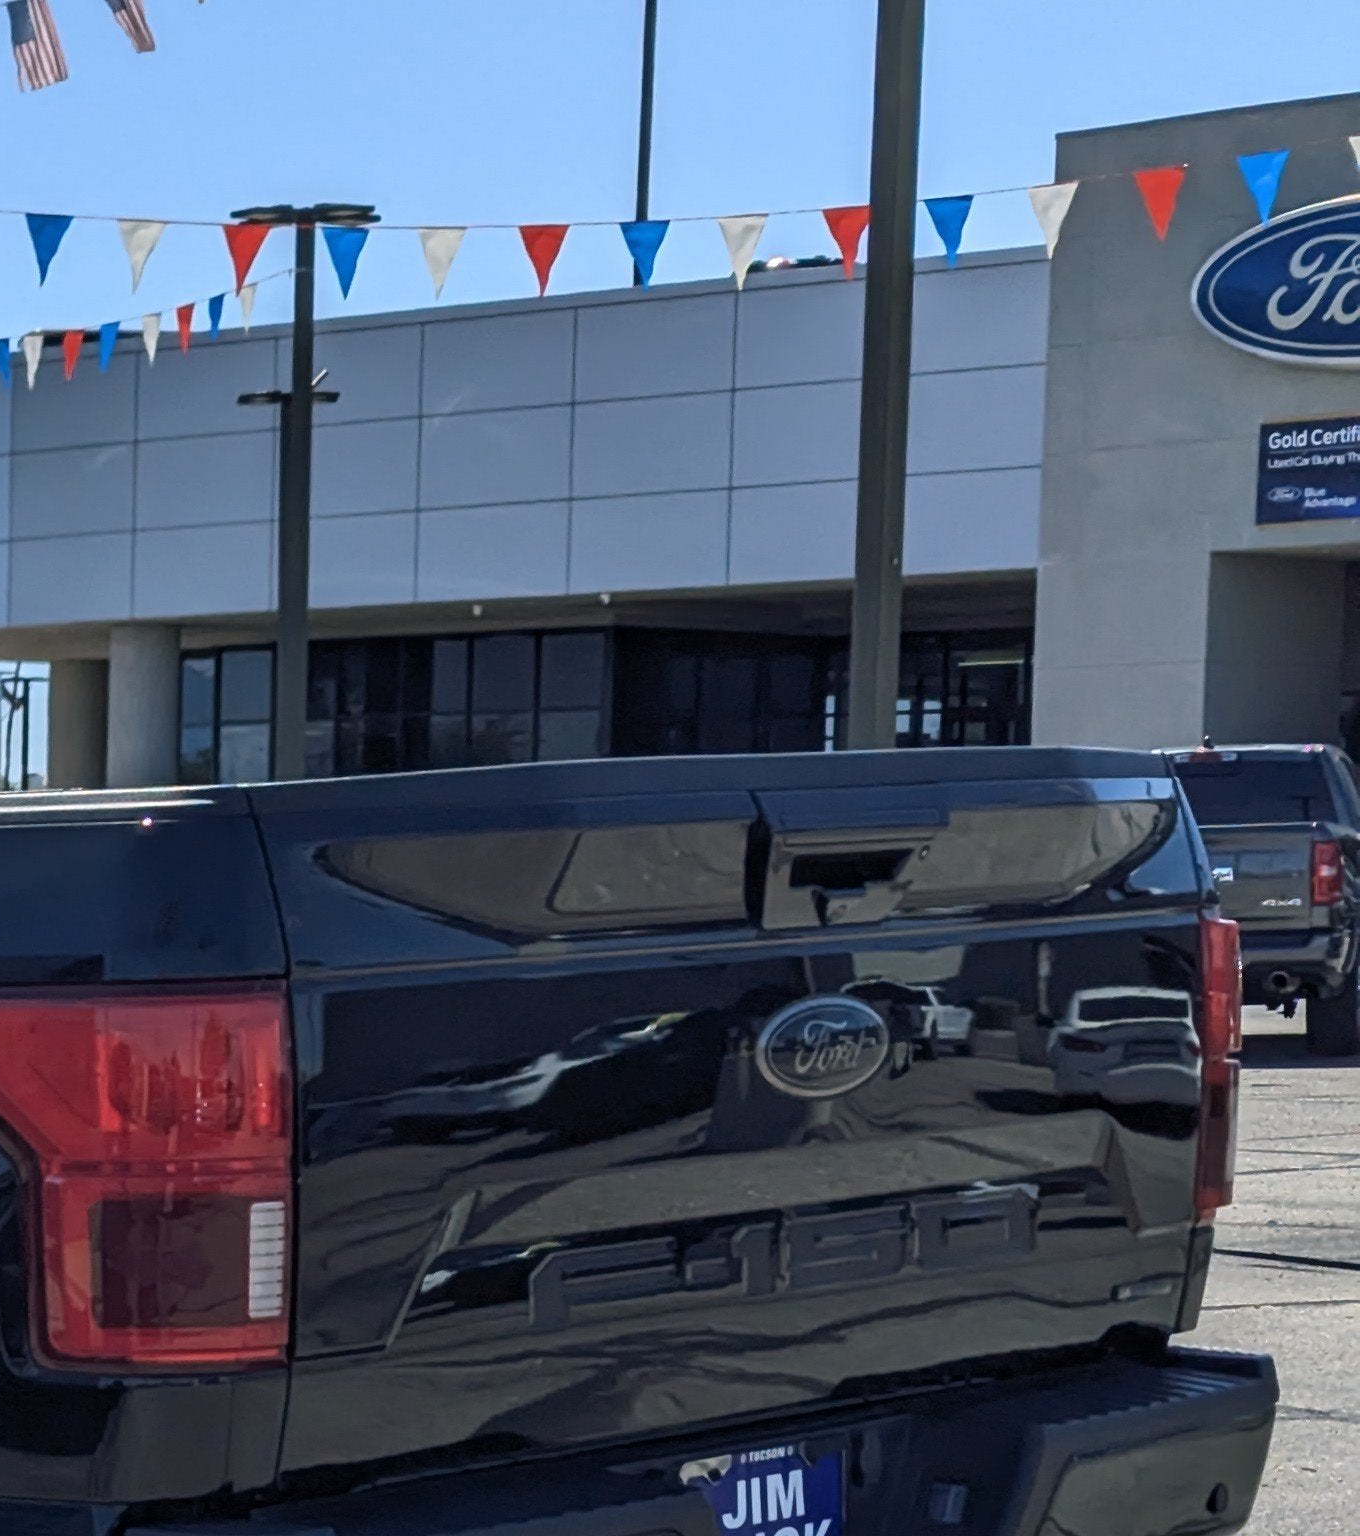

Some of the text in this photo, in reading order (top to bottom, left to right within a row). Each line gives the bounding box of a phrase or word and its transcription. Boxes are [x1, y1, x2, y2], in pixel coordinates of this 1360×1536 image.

[1267, 233, 1360, 331] Fo
[1268, 429, 1308, 449] Gold
[794, 1020, 877, 1074] Ford
[529, 1185, 1039, 1326] F-150
[722, 1469, 806, 1530] JIM
